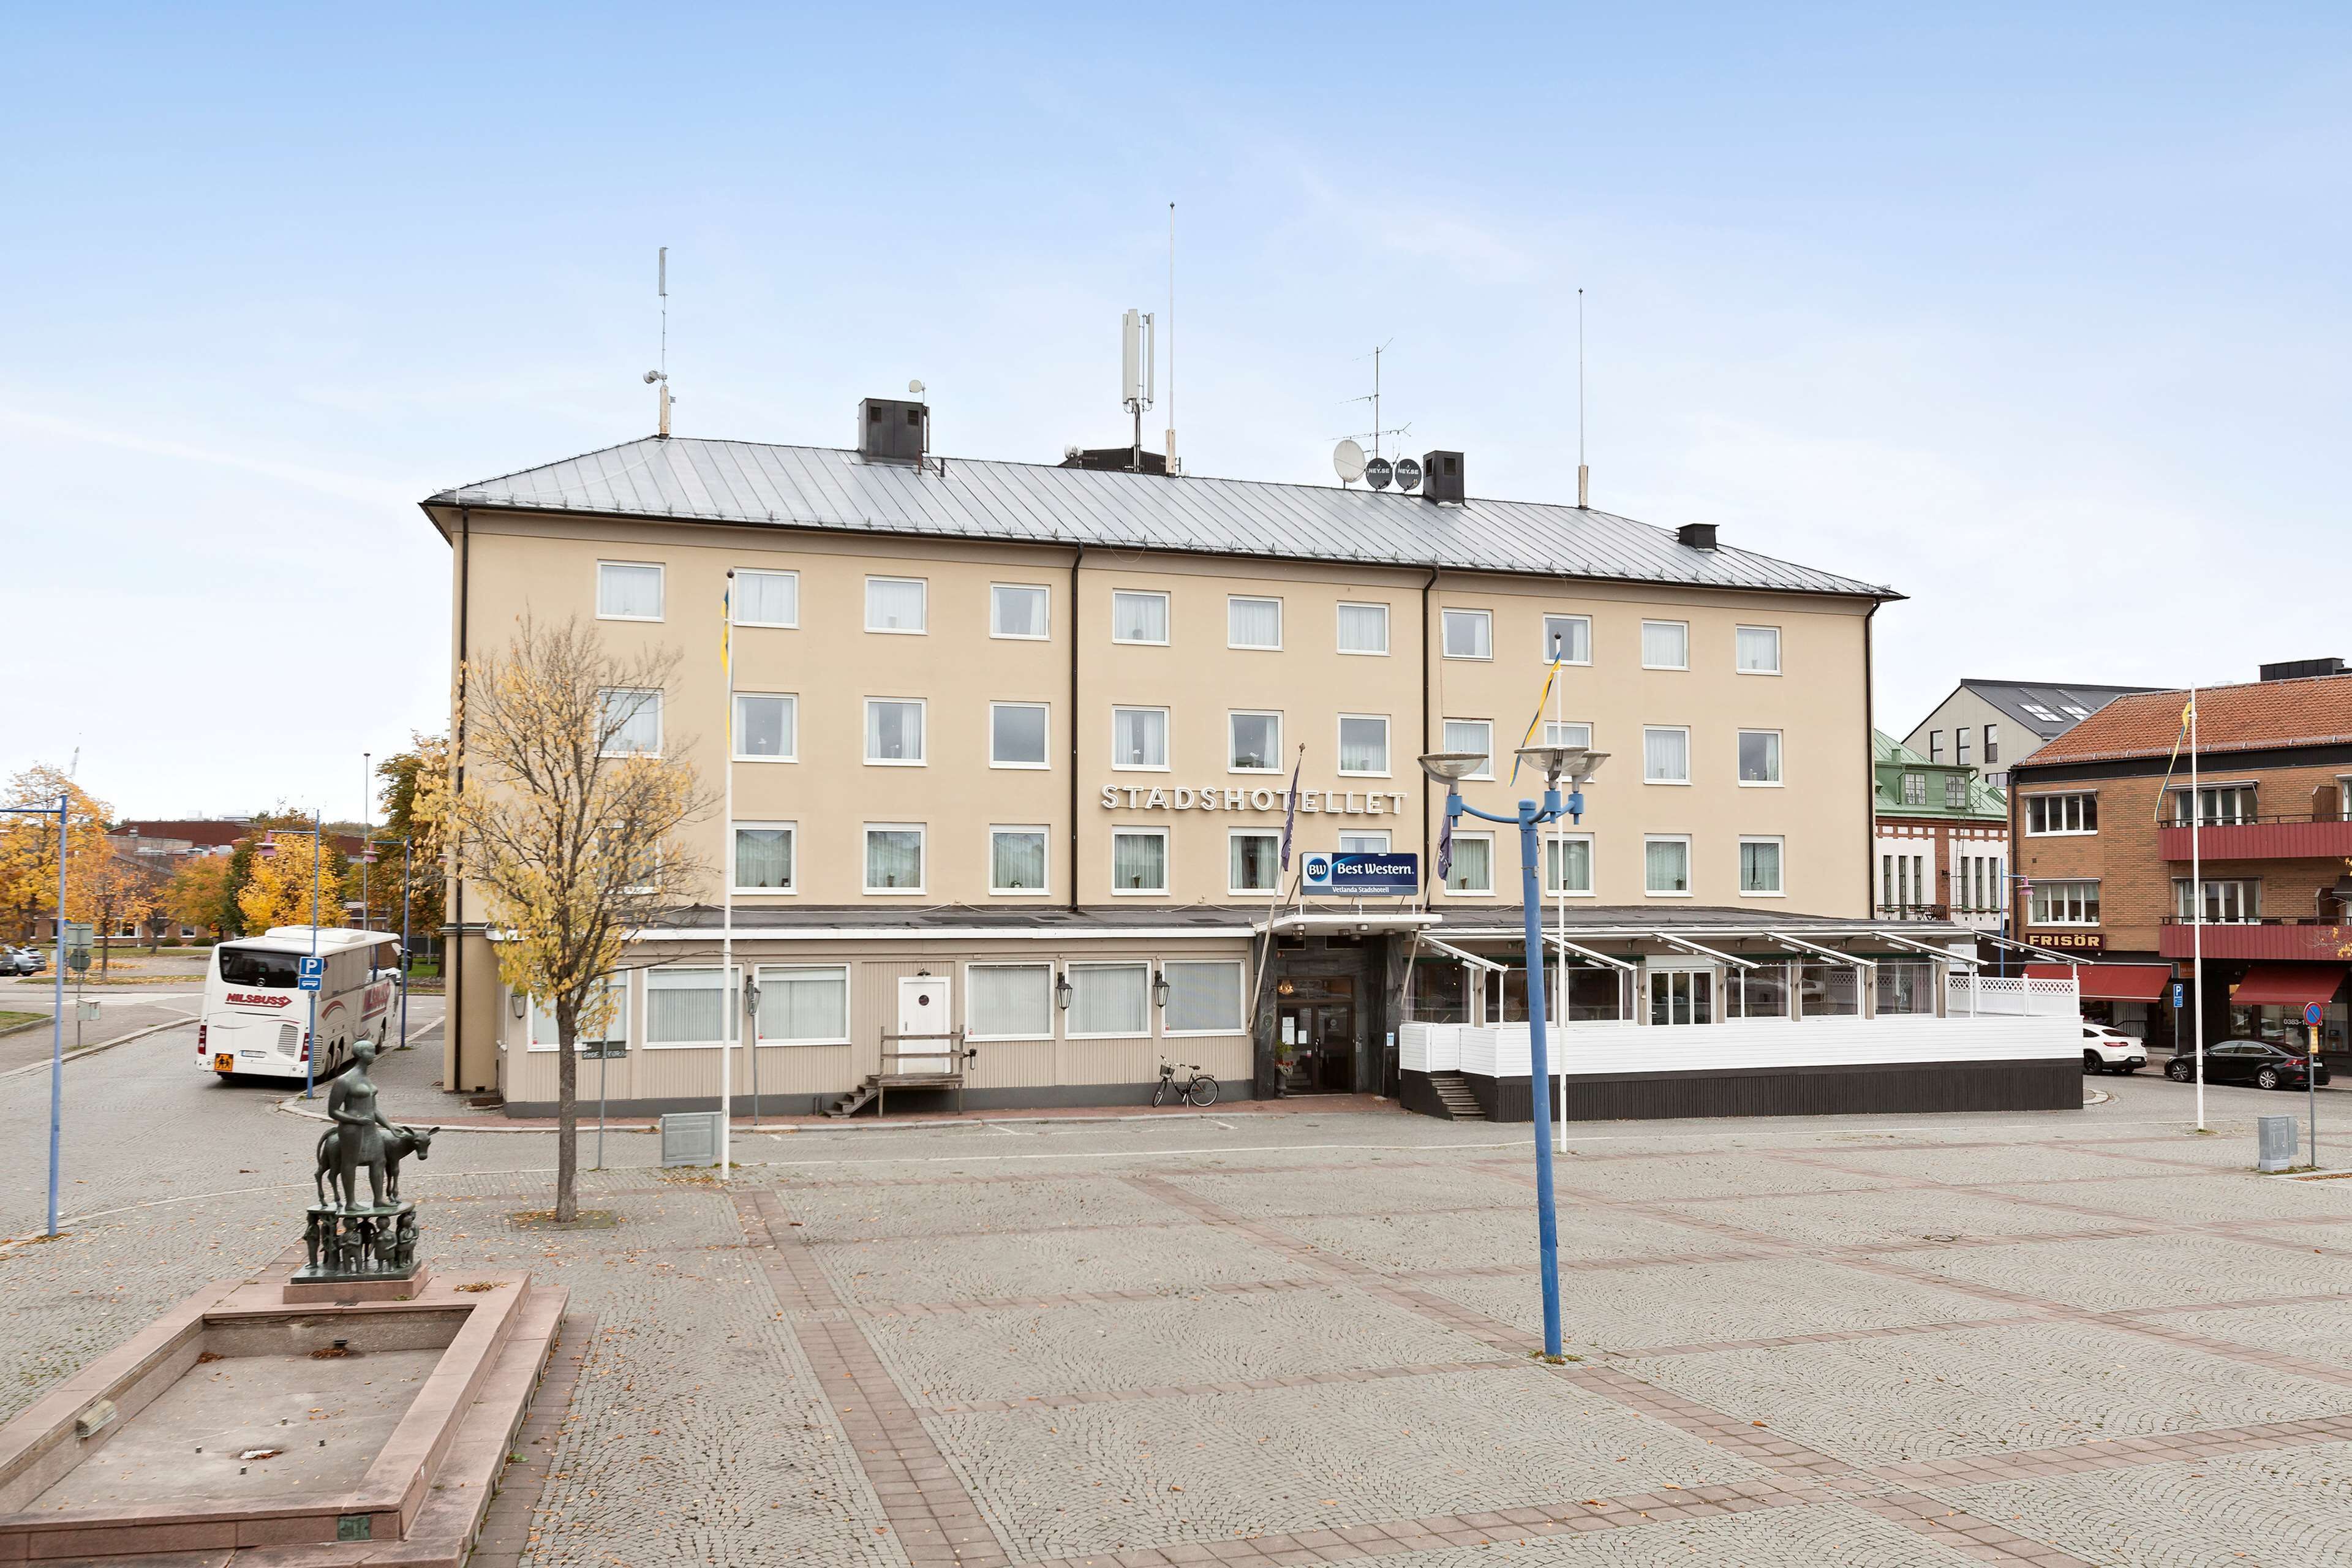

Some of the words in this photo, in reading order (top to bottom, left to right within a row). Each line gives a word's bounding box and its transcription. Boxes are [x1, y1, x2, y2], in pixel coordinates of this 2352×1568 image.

[1101, 784, 1408, 815] STADSHOTELLET
[1309, 864, 1327, 875] BW
[1337, 863, 1363, 874] Best
[2029, 935, 2100, 946] FRISÖR
[306, 959, 318, 973] P
[2176, 986, 2181, 996] P
[226, 993, 286, 1005] NILSBUSS
